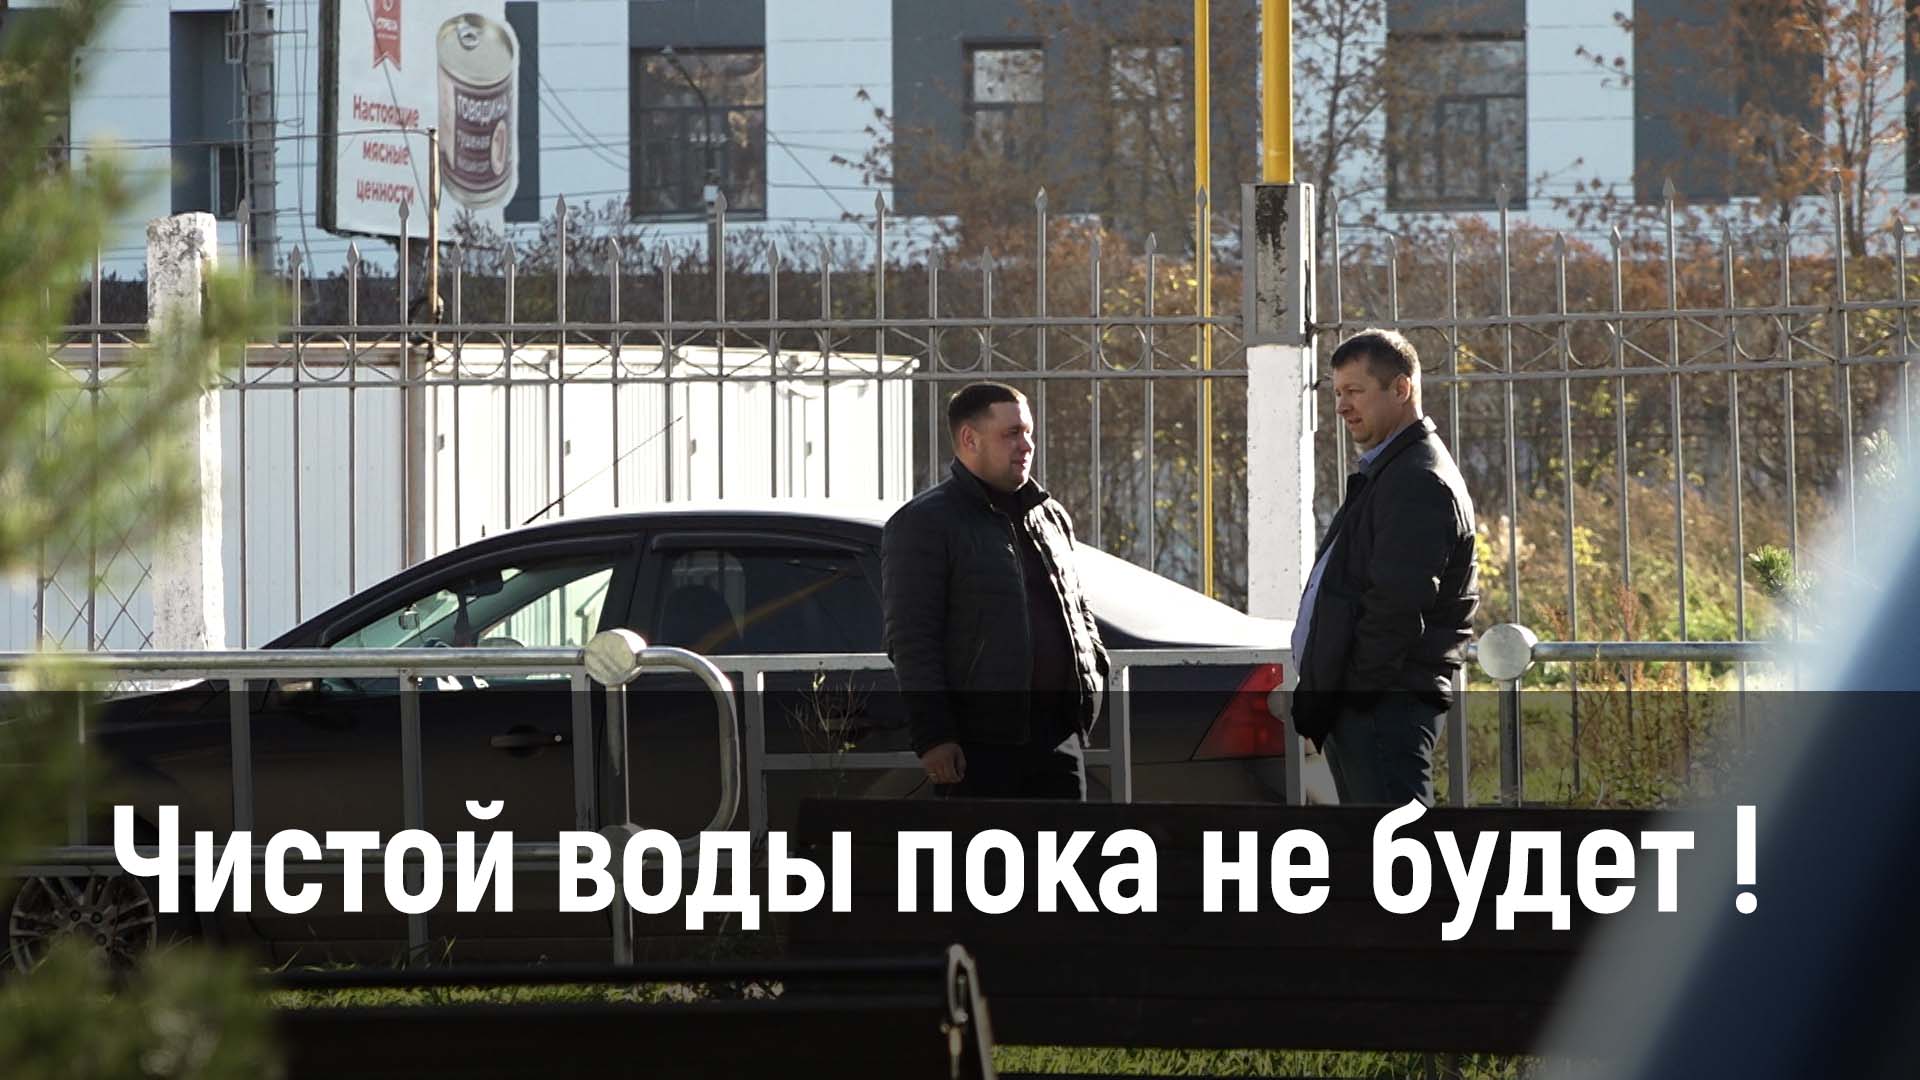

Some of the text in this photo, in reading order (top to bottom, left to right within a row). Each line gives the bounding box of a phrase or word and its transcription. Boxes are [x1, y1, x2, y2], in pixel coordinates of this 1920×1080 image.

[353, 94, 419, 128] Настоящие
[363, 141, 410, 165] мясные
[356, 178, 415, 205] ценности
